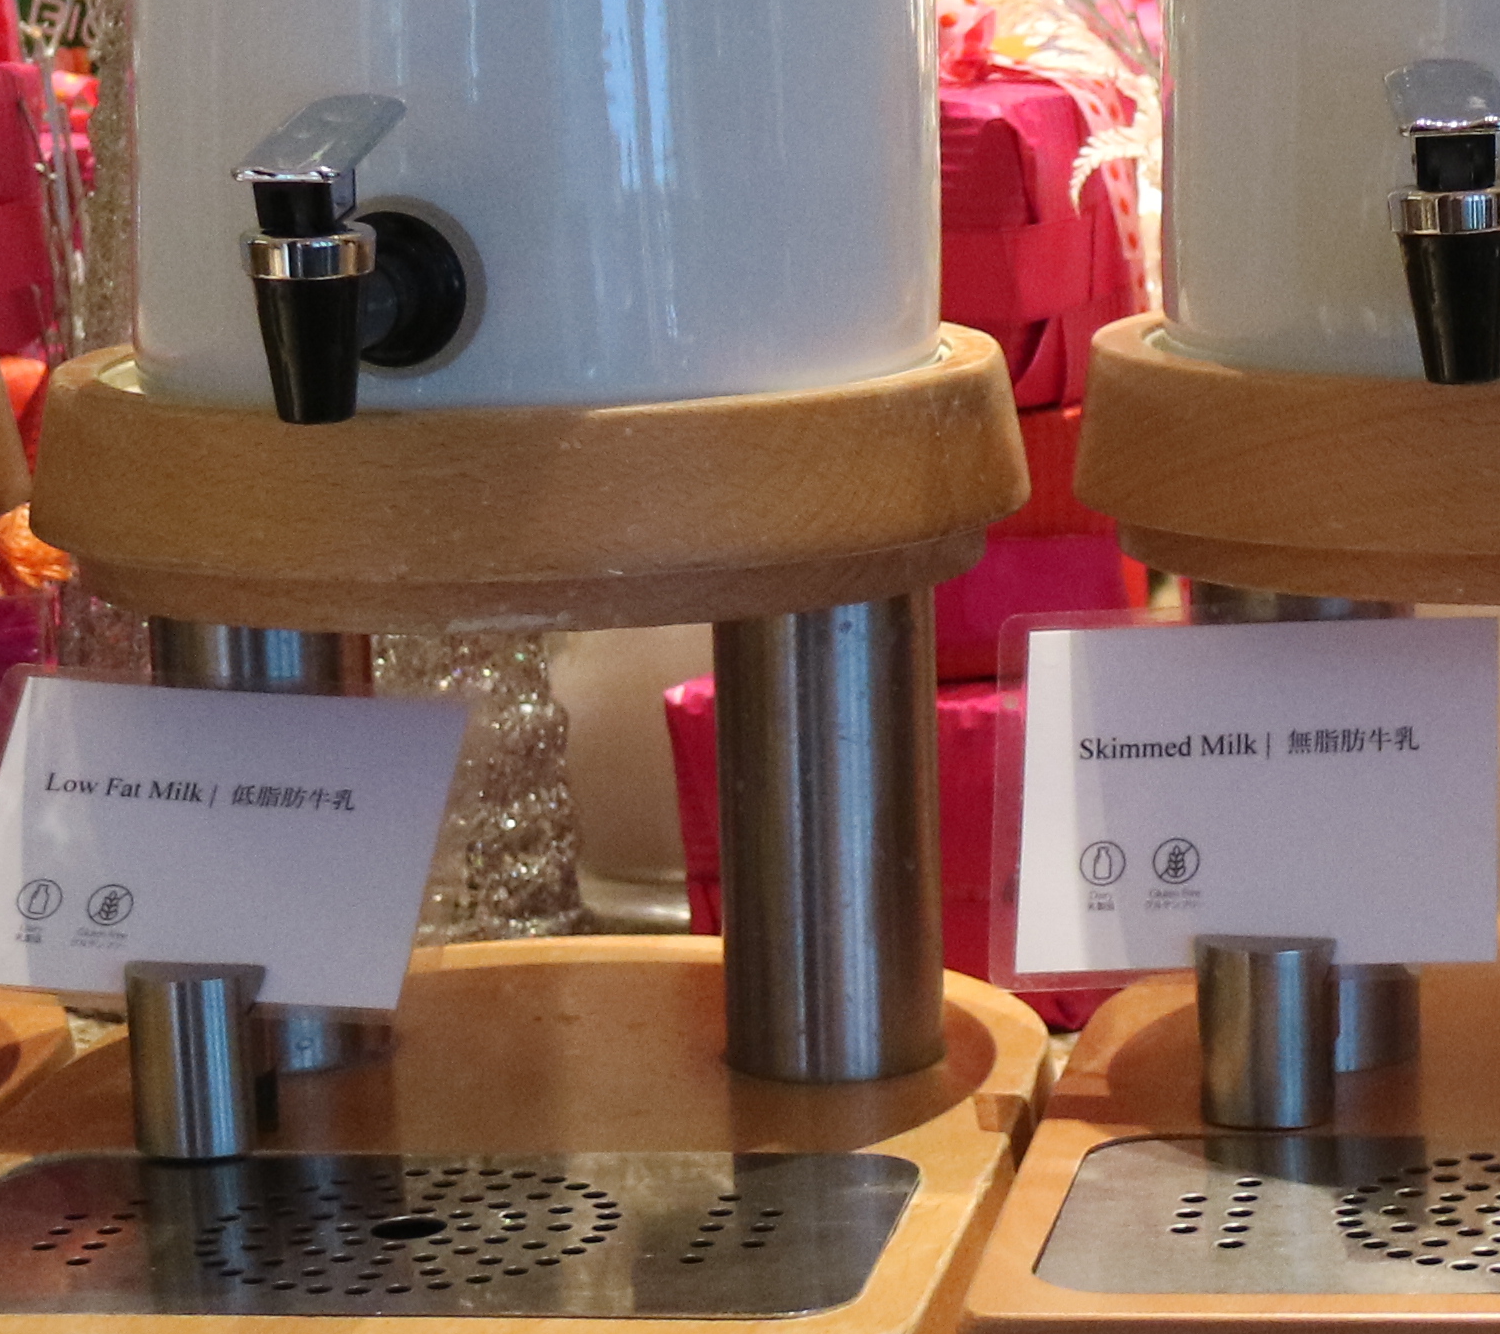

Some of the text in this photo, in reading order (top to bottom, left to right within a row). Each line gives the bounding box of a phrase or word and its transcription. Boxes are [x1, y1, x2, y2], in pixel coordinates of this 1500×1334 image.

[1078, 735, 1192, 761] Skimmed
[1201, 732, 1257, 757] Milk
[1288, 725, 1420, 754] 無脂肪牛乳
[44, 771, 98, 794] Low
[105, 776, 141, 799] Fat
[148, 779, 202, 804] Milk
[232, 783, 355, 812] 低脂肪牛乳
